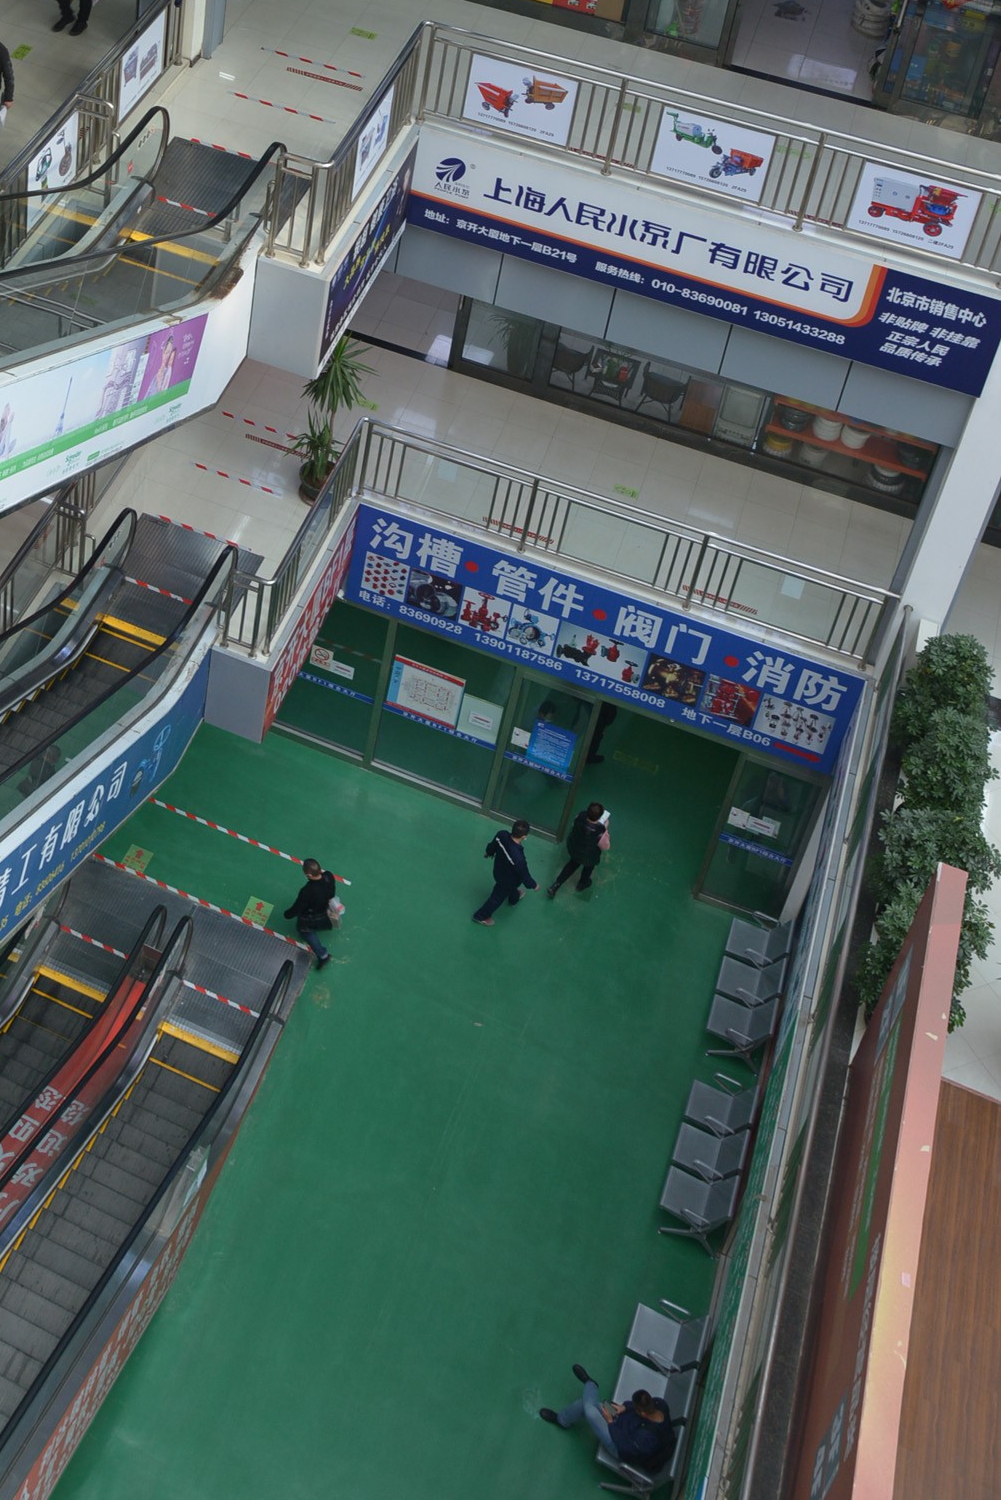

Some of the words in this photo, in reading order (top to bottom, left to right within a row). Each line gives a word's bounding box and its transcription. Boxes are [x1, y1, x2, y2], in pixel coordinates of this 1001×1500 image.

[456, 217, 578, 264] 京开大厦地下一层B21号
[651, 279, 748, 316] 010-83690081
[753, 310, 846, 346] 13051433288
[483, 177, 854, 303] 上海人民水泵厂有限公司
[878, 312, 930, 334] 非贴牌
[930, 327, 981, 350] 非挂靠
[886, 331, 950, 357] 正宗人民
[887, 287, 988, 329] 北京市销售中心
[879, 343, 943, 368] 品质传承
[369, 518, 465, 579] 沟槽
[492, 559, 586, 619] 管件
[613, 605, 713, 666] 阀门
[742, 650, 848, 713] 消防
[359, 589, 391, 610] 电话:
[399, 604, 463, 636] 83690928
[474, 631, 564, 672] 13901187586
[575, 668, 667, 709] 13717558008
[681, 706, 772, 748] 地下一层B06
